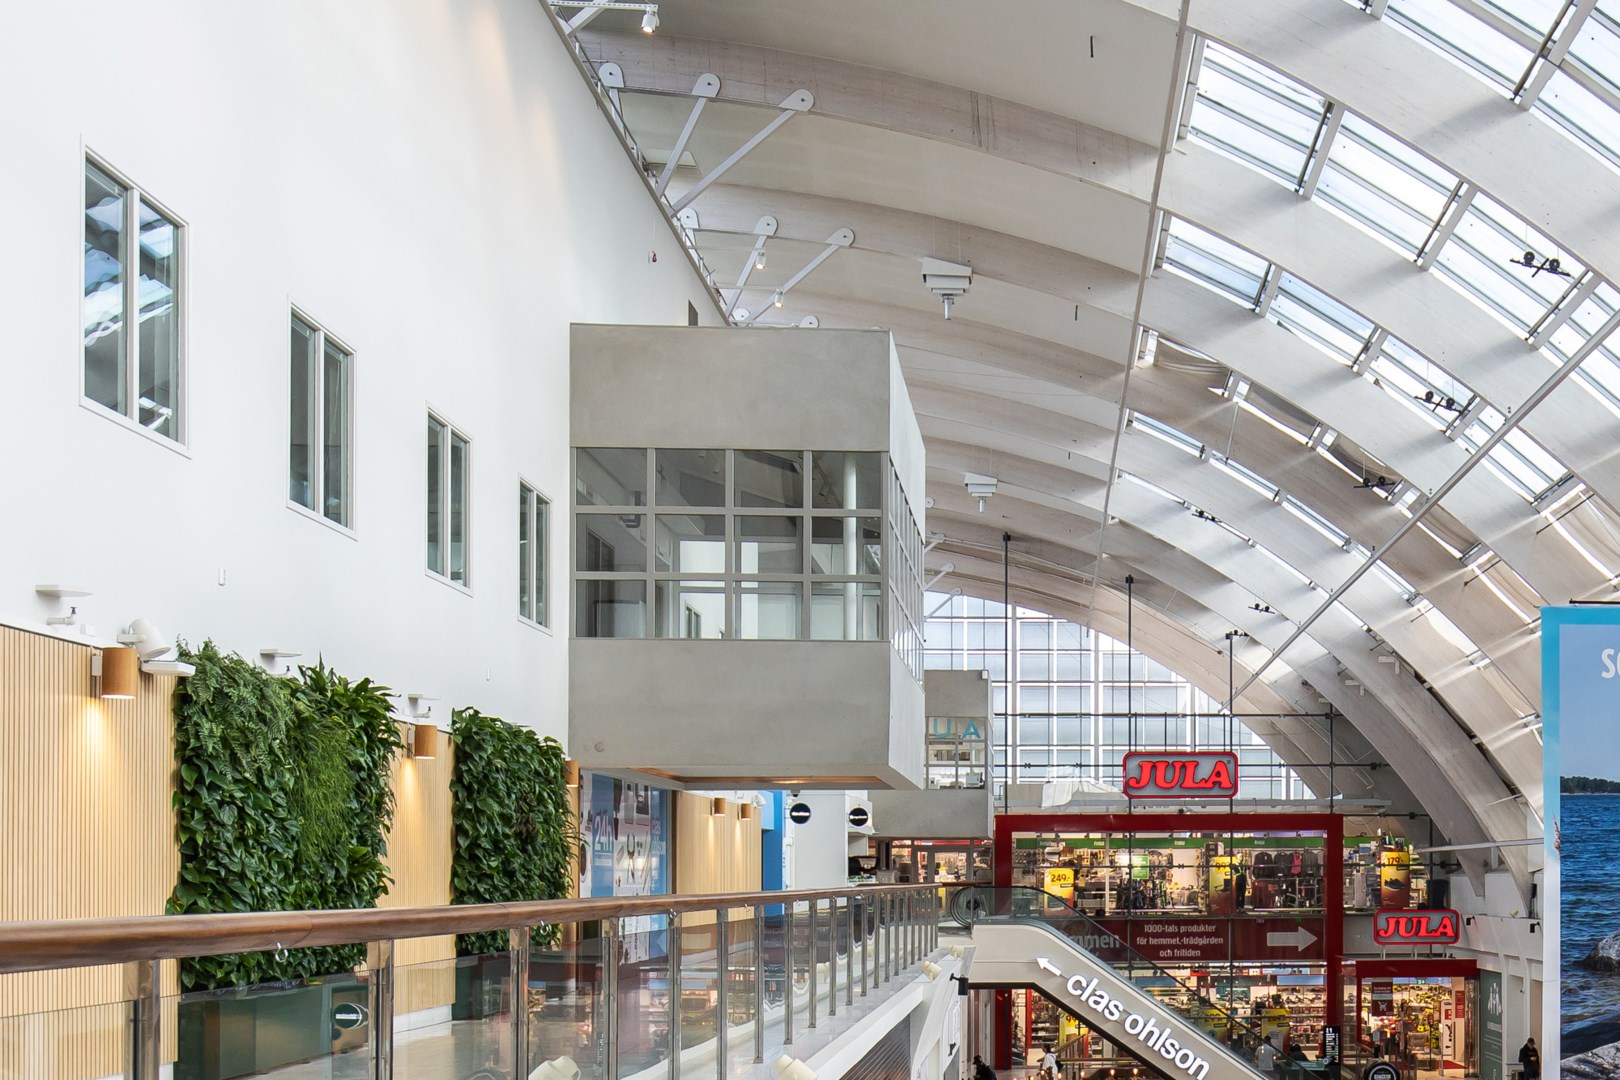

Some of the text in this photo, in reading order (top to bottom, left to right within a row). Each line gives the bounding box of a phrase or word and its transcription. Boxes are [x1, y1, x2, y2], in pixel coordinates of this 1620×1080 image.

[1127, 760, 1233, 789] JULA
[1180, 924, 1216, 934] produkter
[1378, 915, 1455, 938] JULA
[1159, 948, 1201, 957] och fritiden
[1066, 974, 1210, 1080] clas ohlson
